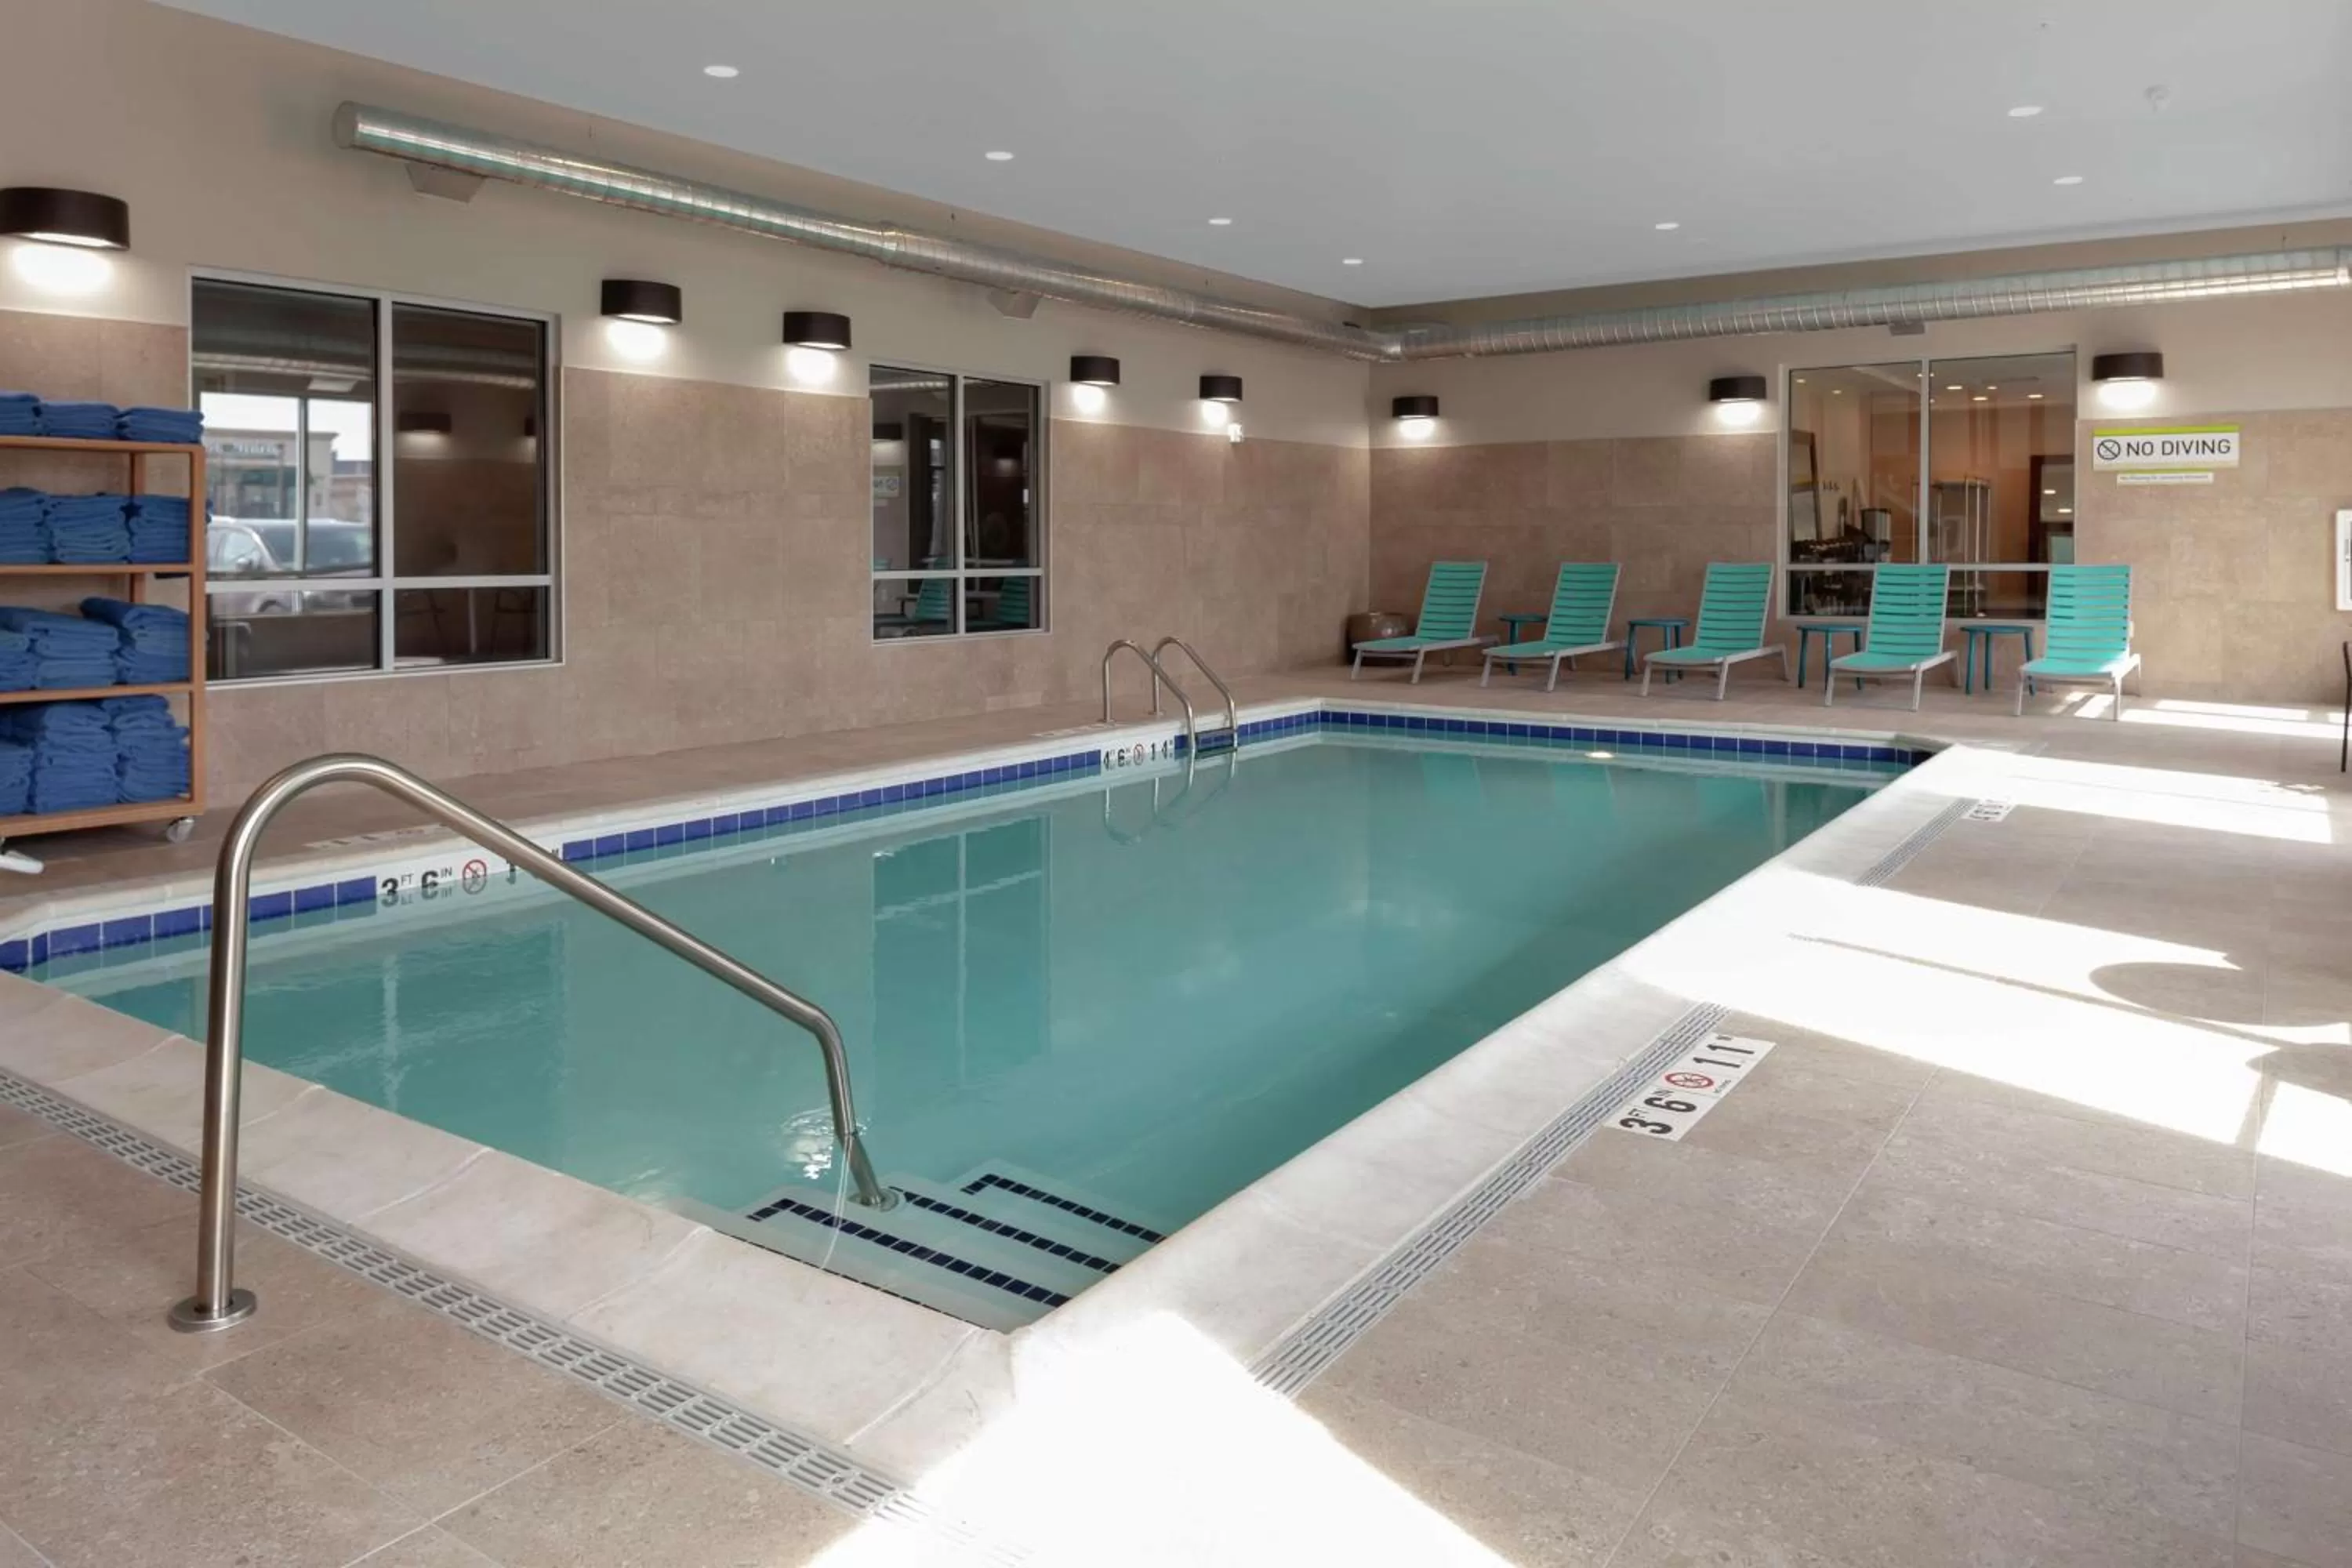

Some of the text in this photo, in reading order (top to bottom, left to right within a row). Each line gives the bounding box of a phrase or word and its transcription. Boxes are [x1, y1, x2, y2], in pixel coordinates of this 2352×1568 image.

[2126, 438, 2230, 457] NO DIVING
[401, 873, 414, 887] FT
[441, 866, 452, 879] IN
[1628, 1108, 1650, 1118] FT
[1643, 1097, 1697, 1112] 6
[1620, 1117, 1673, 1134] 3
